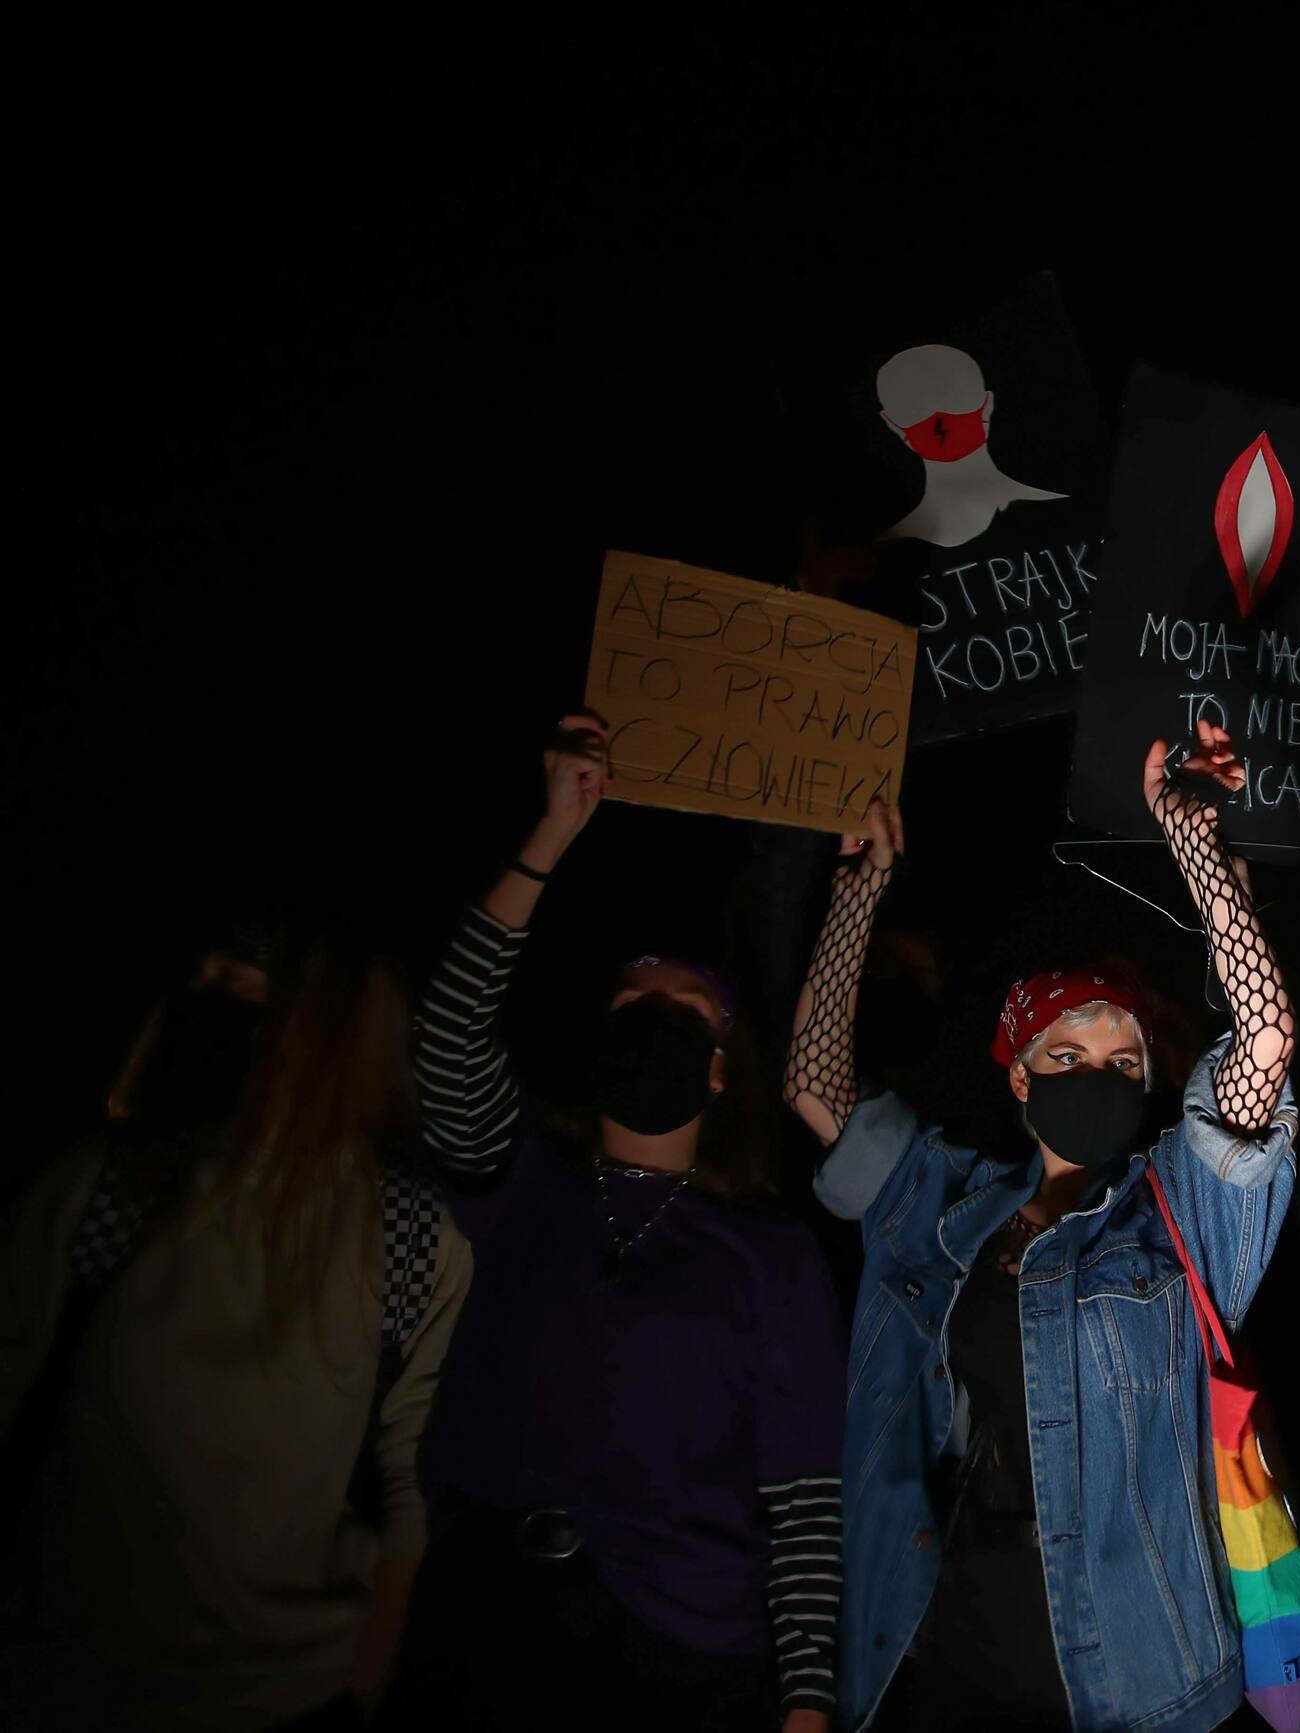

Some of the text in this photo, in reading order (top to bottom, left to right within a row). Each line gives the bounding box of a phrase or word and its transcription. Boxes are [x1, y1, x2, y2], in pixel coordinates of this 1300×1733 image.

[919, 542, 1098, 632] STRAJK
[610, 576, 902, 694] ABORCJA
[925, 611, 1092, 698] KOBIE
[1139, 613, 1248, 680] MOJA
[606, 648, 899, 749] TO PRAWO
